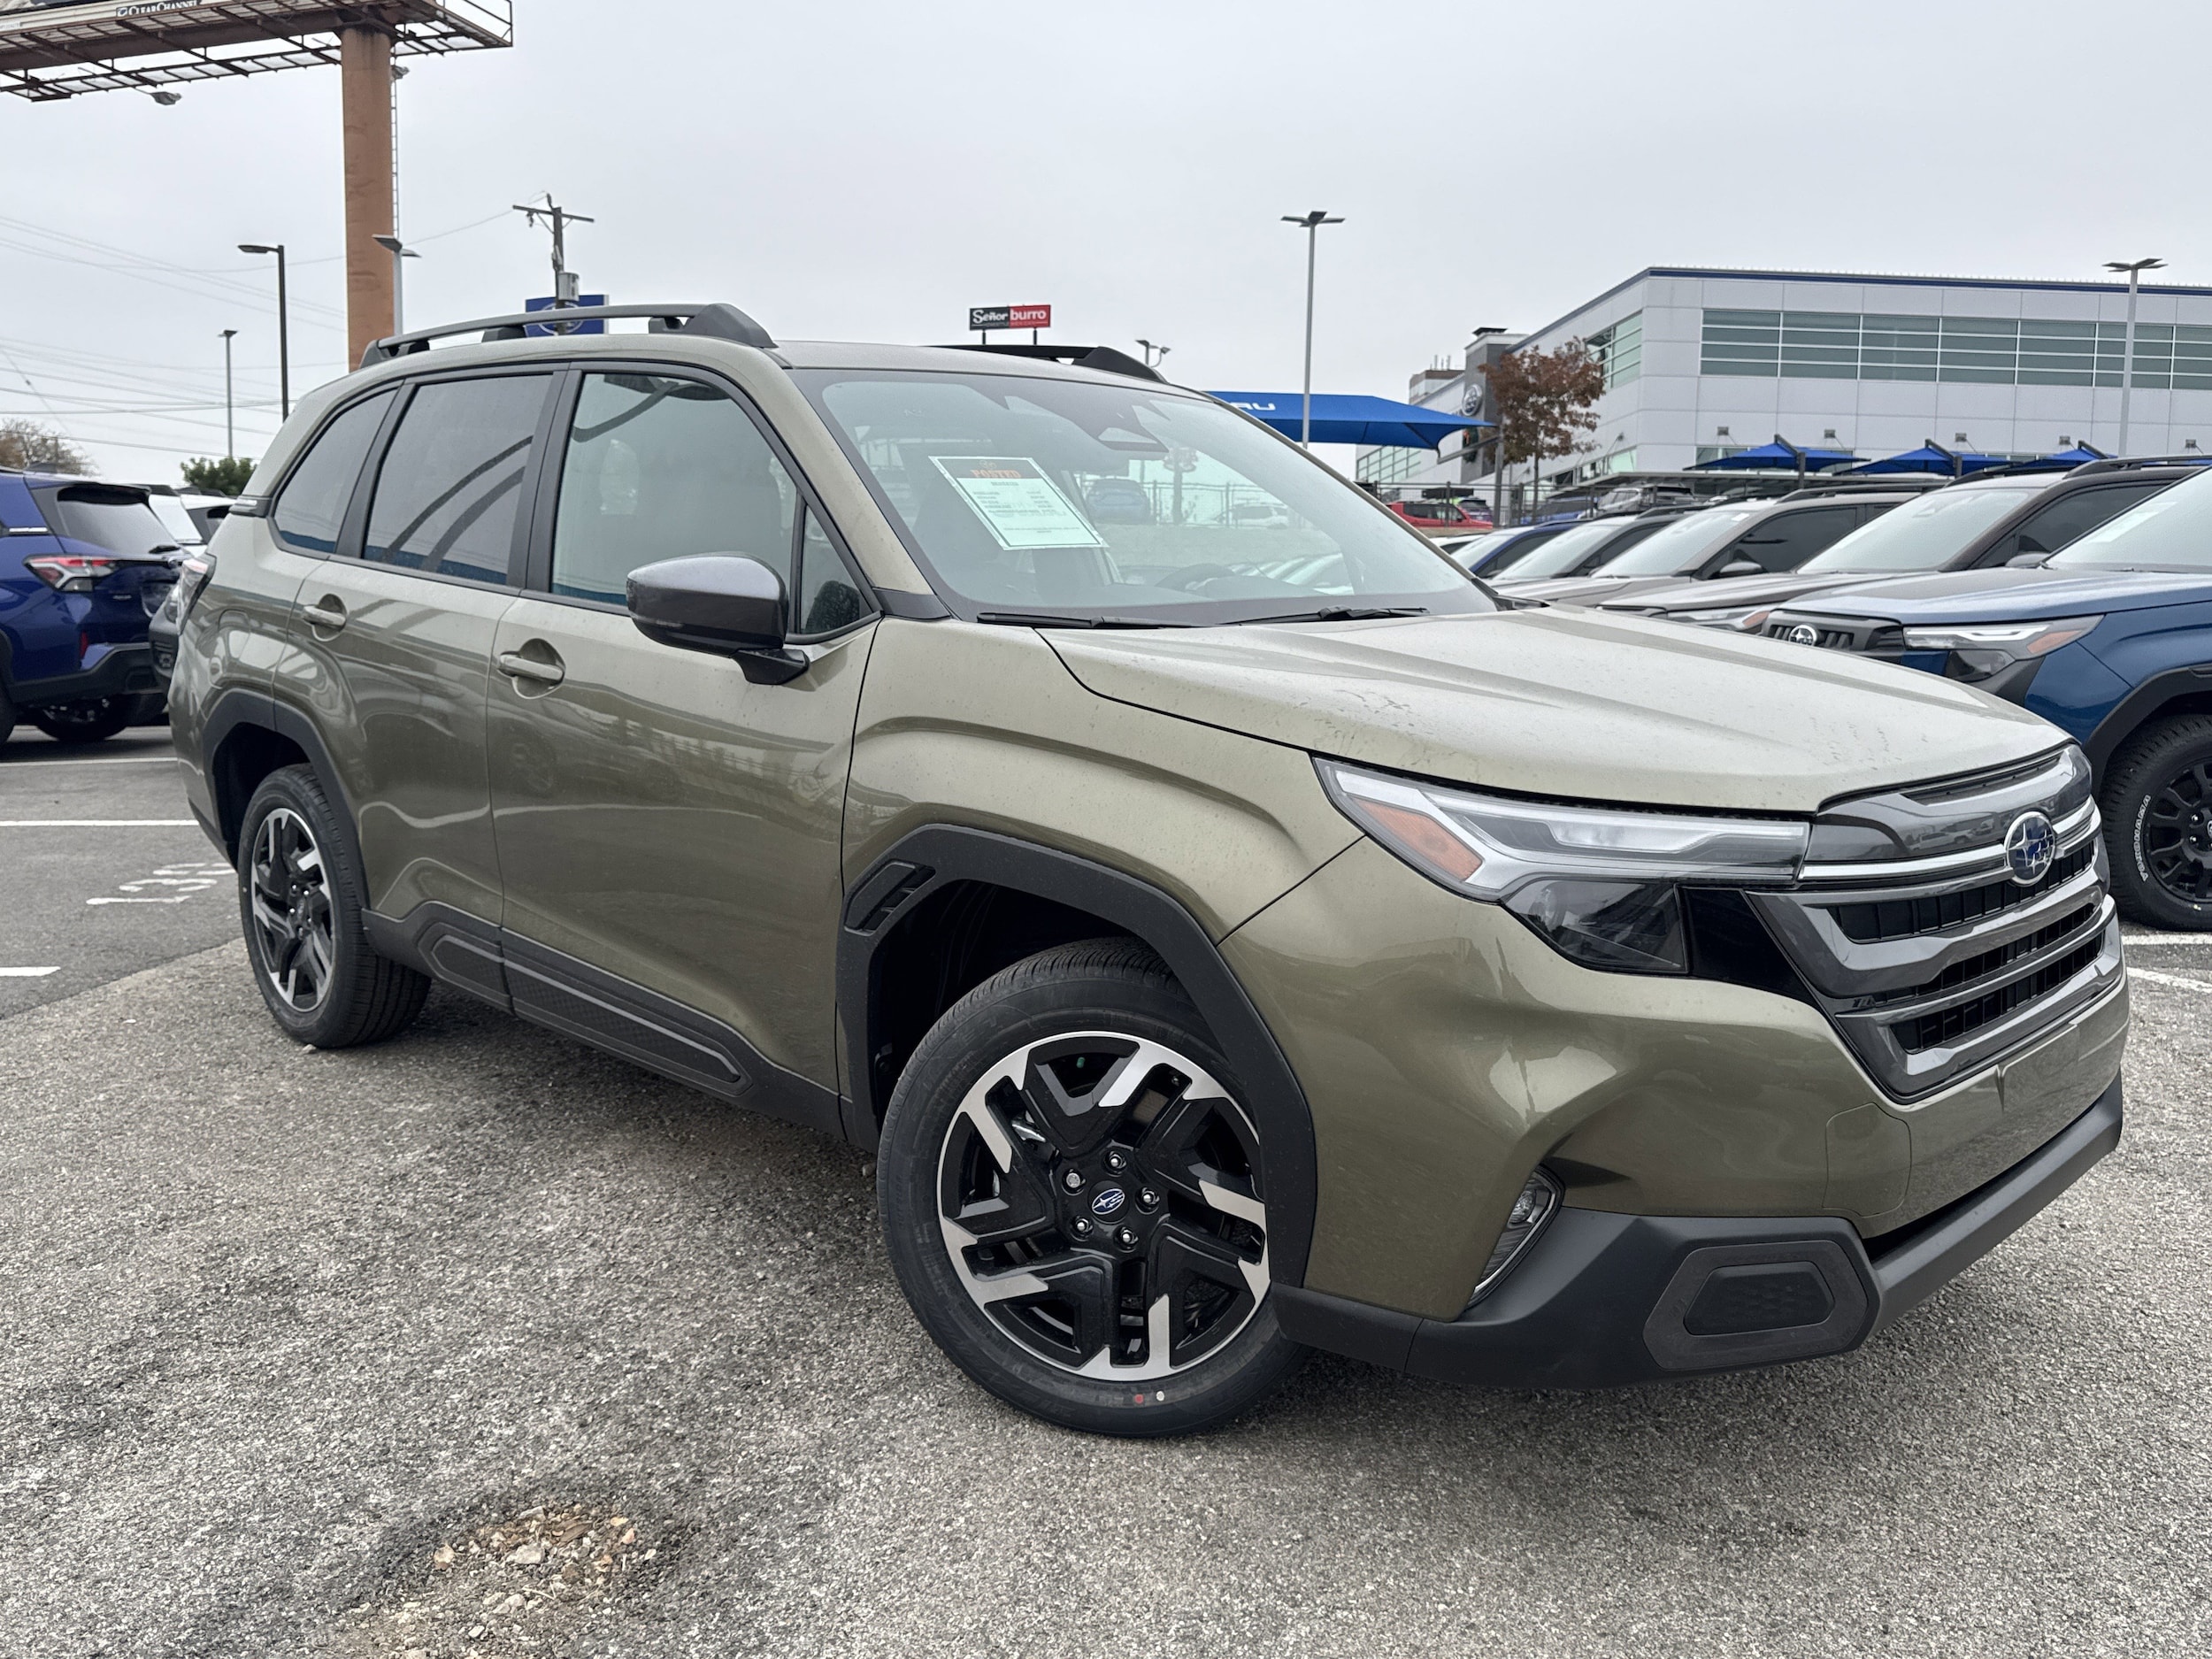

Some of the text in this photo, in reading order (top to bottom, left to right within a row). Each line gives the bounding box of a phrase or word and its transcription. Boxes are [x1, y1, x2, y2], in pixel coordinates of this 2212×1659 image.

[972, 309, 1008, 324] Señor
[1009, 309, 1047, 320] burro
[970, 469, 1022, 479] POSTED
[2133, 795, 2152, 882] YOKOHAMA
